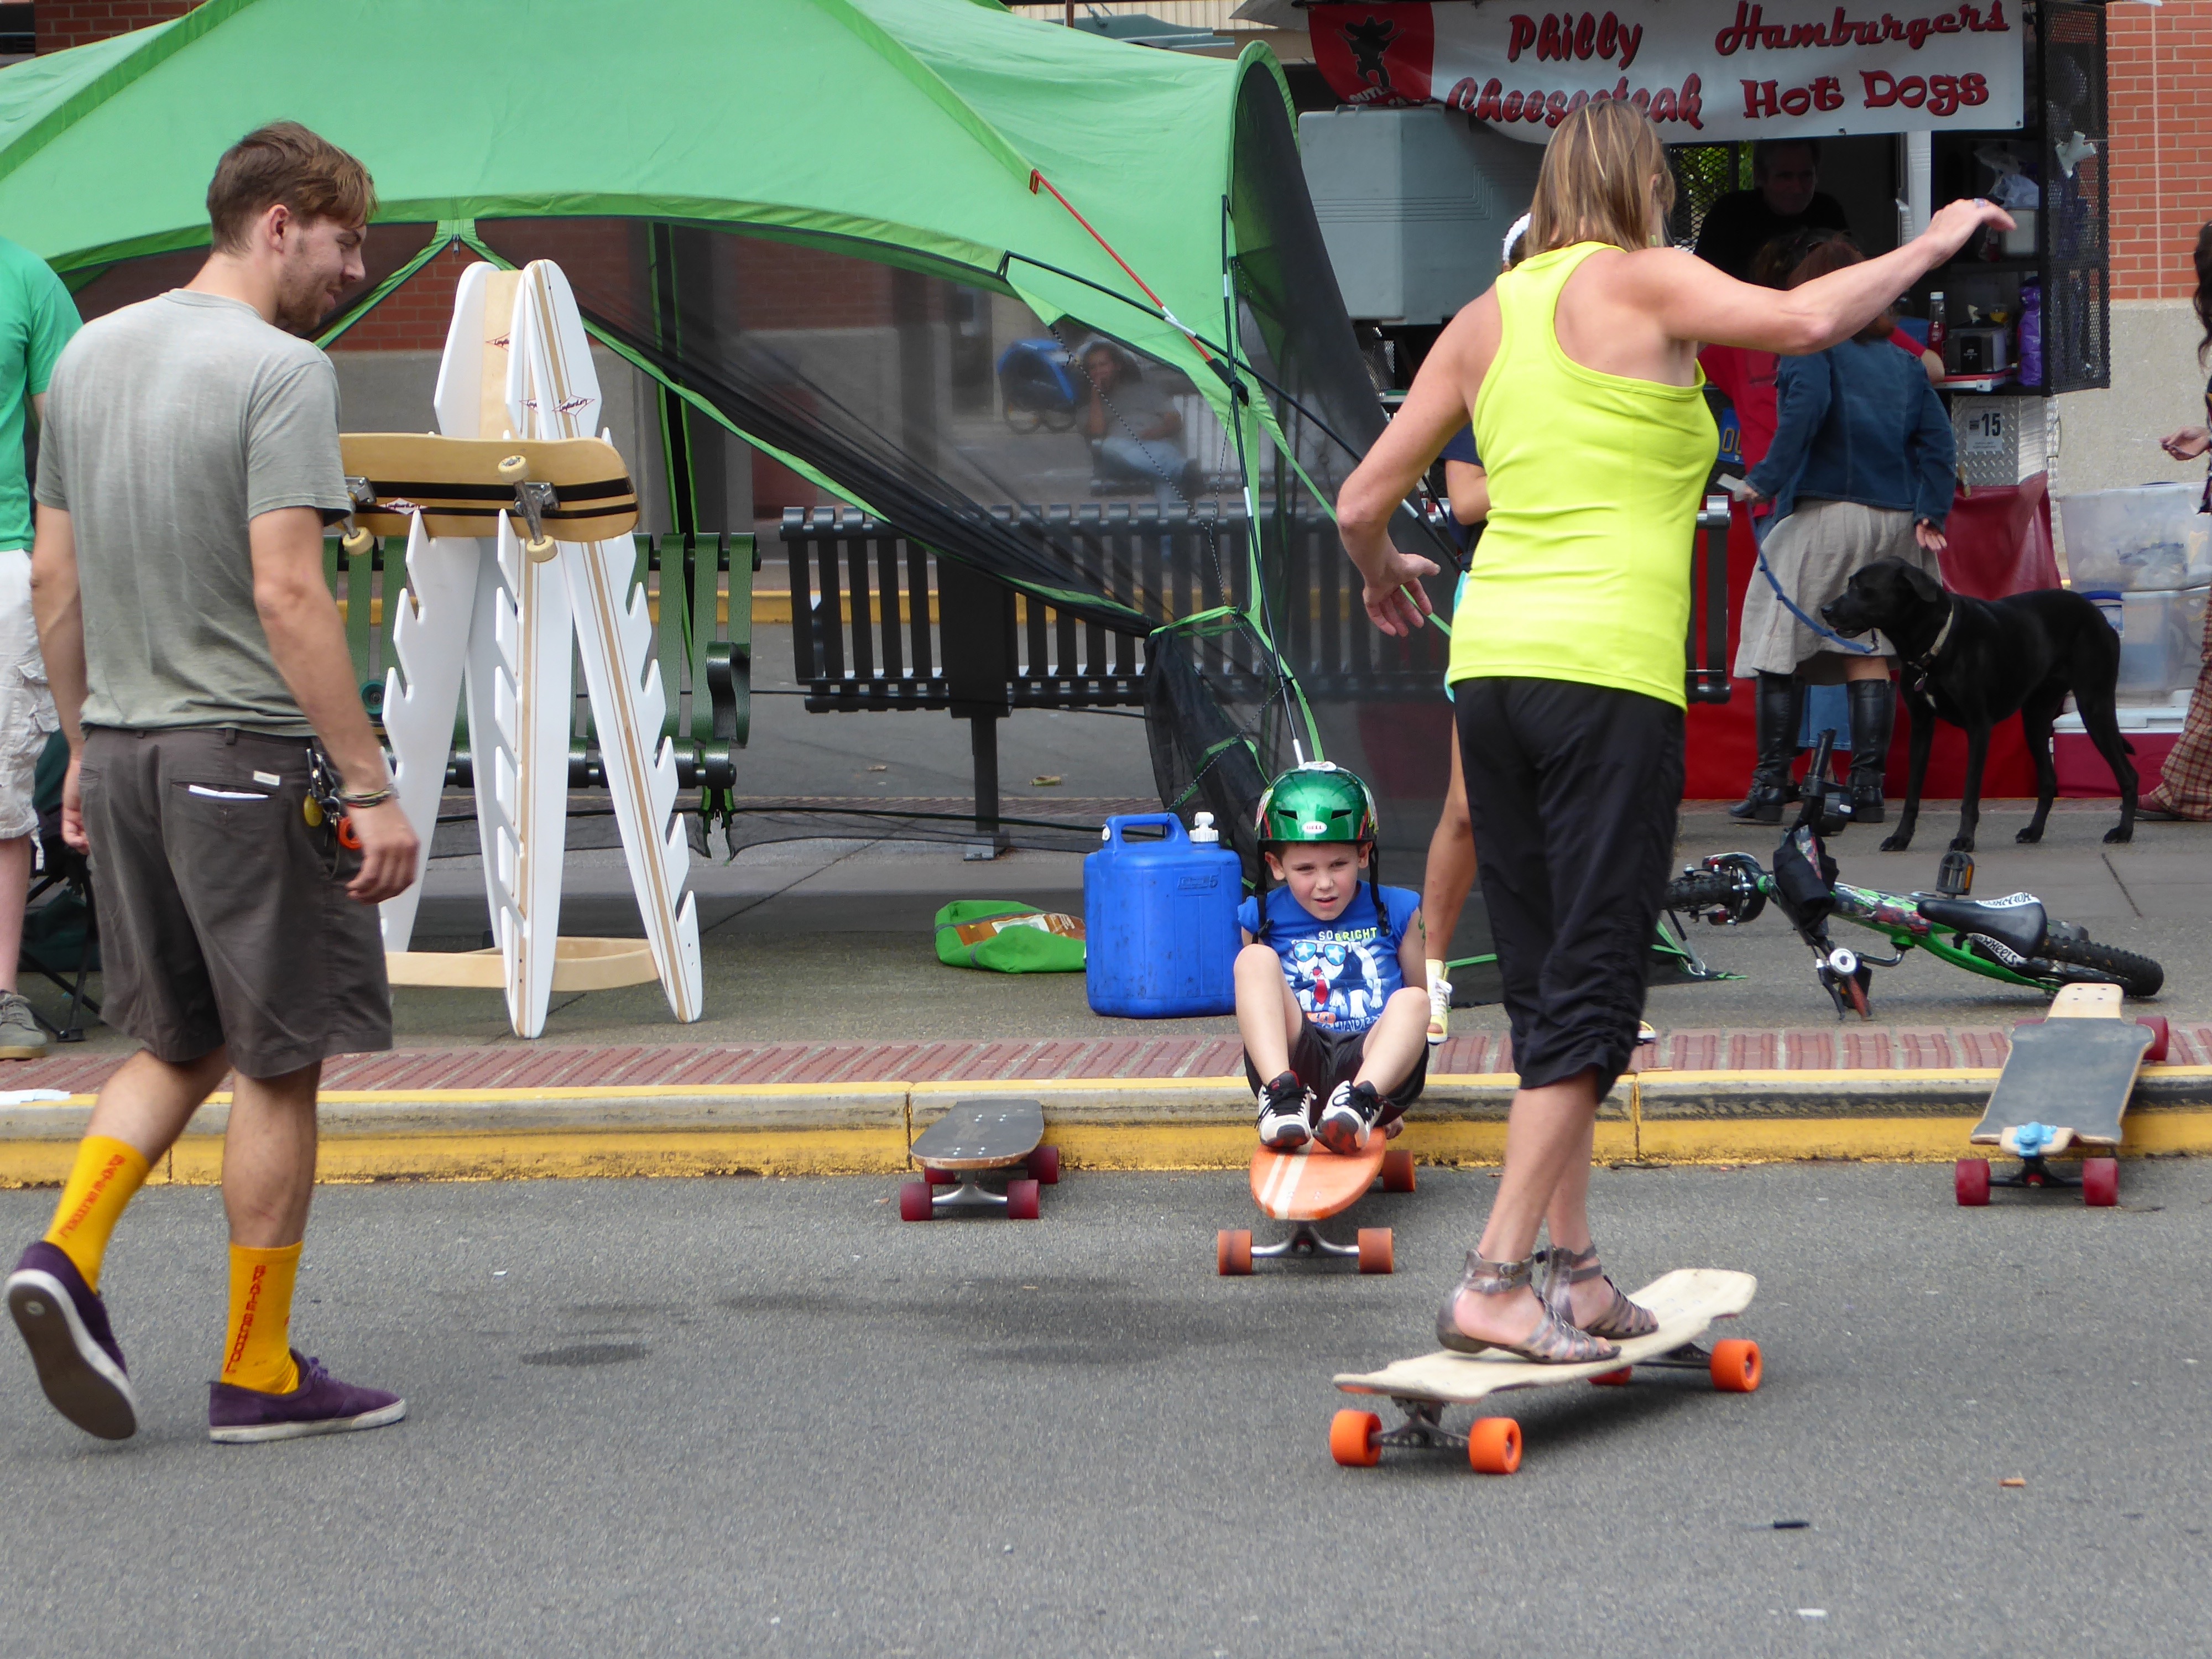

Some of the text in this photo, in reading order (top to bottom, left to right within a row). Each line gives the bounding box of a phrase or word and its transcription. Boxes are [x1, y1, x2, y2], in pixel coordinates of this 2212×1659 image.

[1507, 11, 1643, 71] Philly
[1715, 0, 2011, 56] Hamburgers
[1740, 69, 1990, 119] Hot Dogs
[1982, 413, 2001, 437] 15
[1318, 930, 1333, 941] SO
[1334, 927, 1377, 942] BRIGHT
